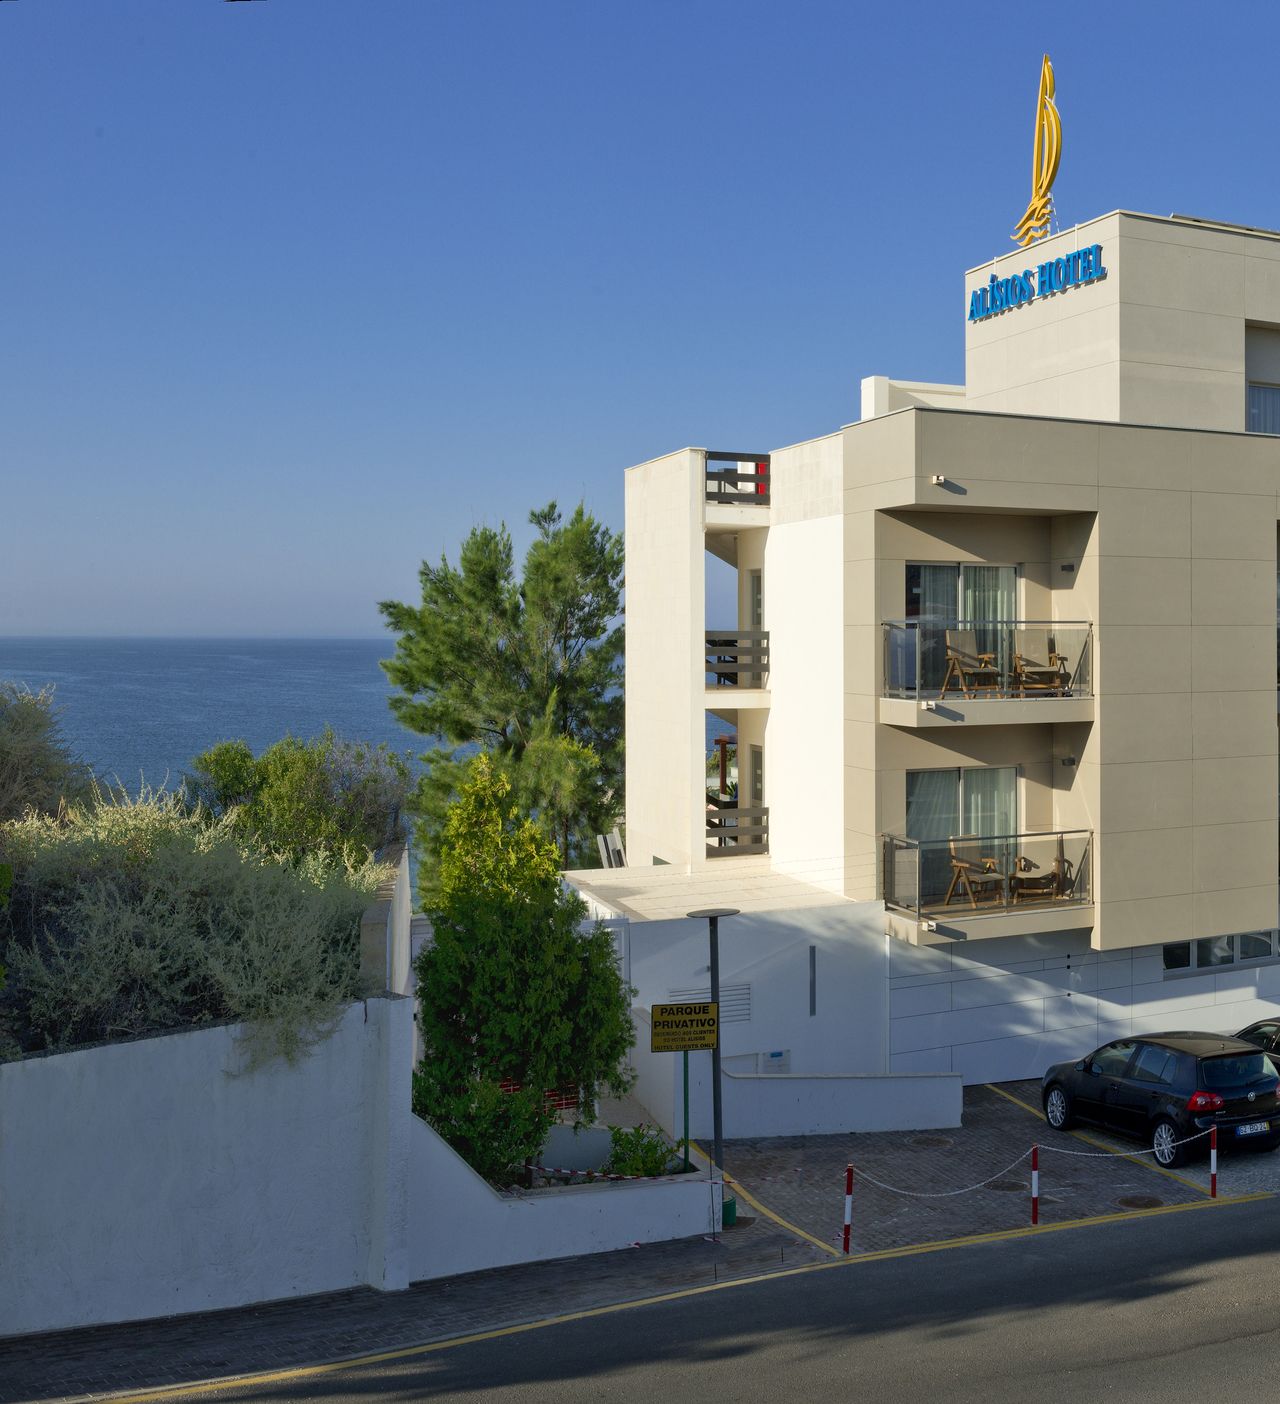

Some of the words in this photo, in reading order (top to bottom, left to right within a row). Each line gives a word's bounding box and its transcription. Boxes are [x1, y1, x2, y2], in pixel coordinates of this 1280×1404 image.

[968, 269, 1035, 321] ALÍSIOS
[1036, 243, 1108, 297] HOTEL
[660, 1005, 710, 1016] PARQUE
[654, 1018, 715, 1029] PRIVATIVO
